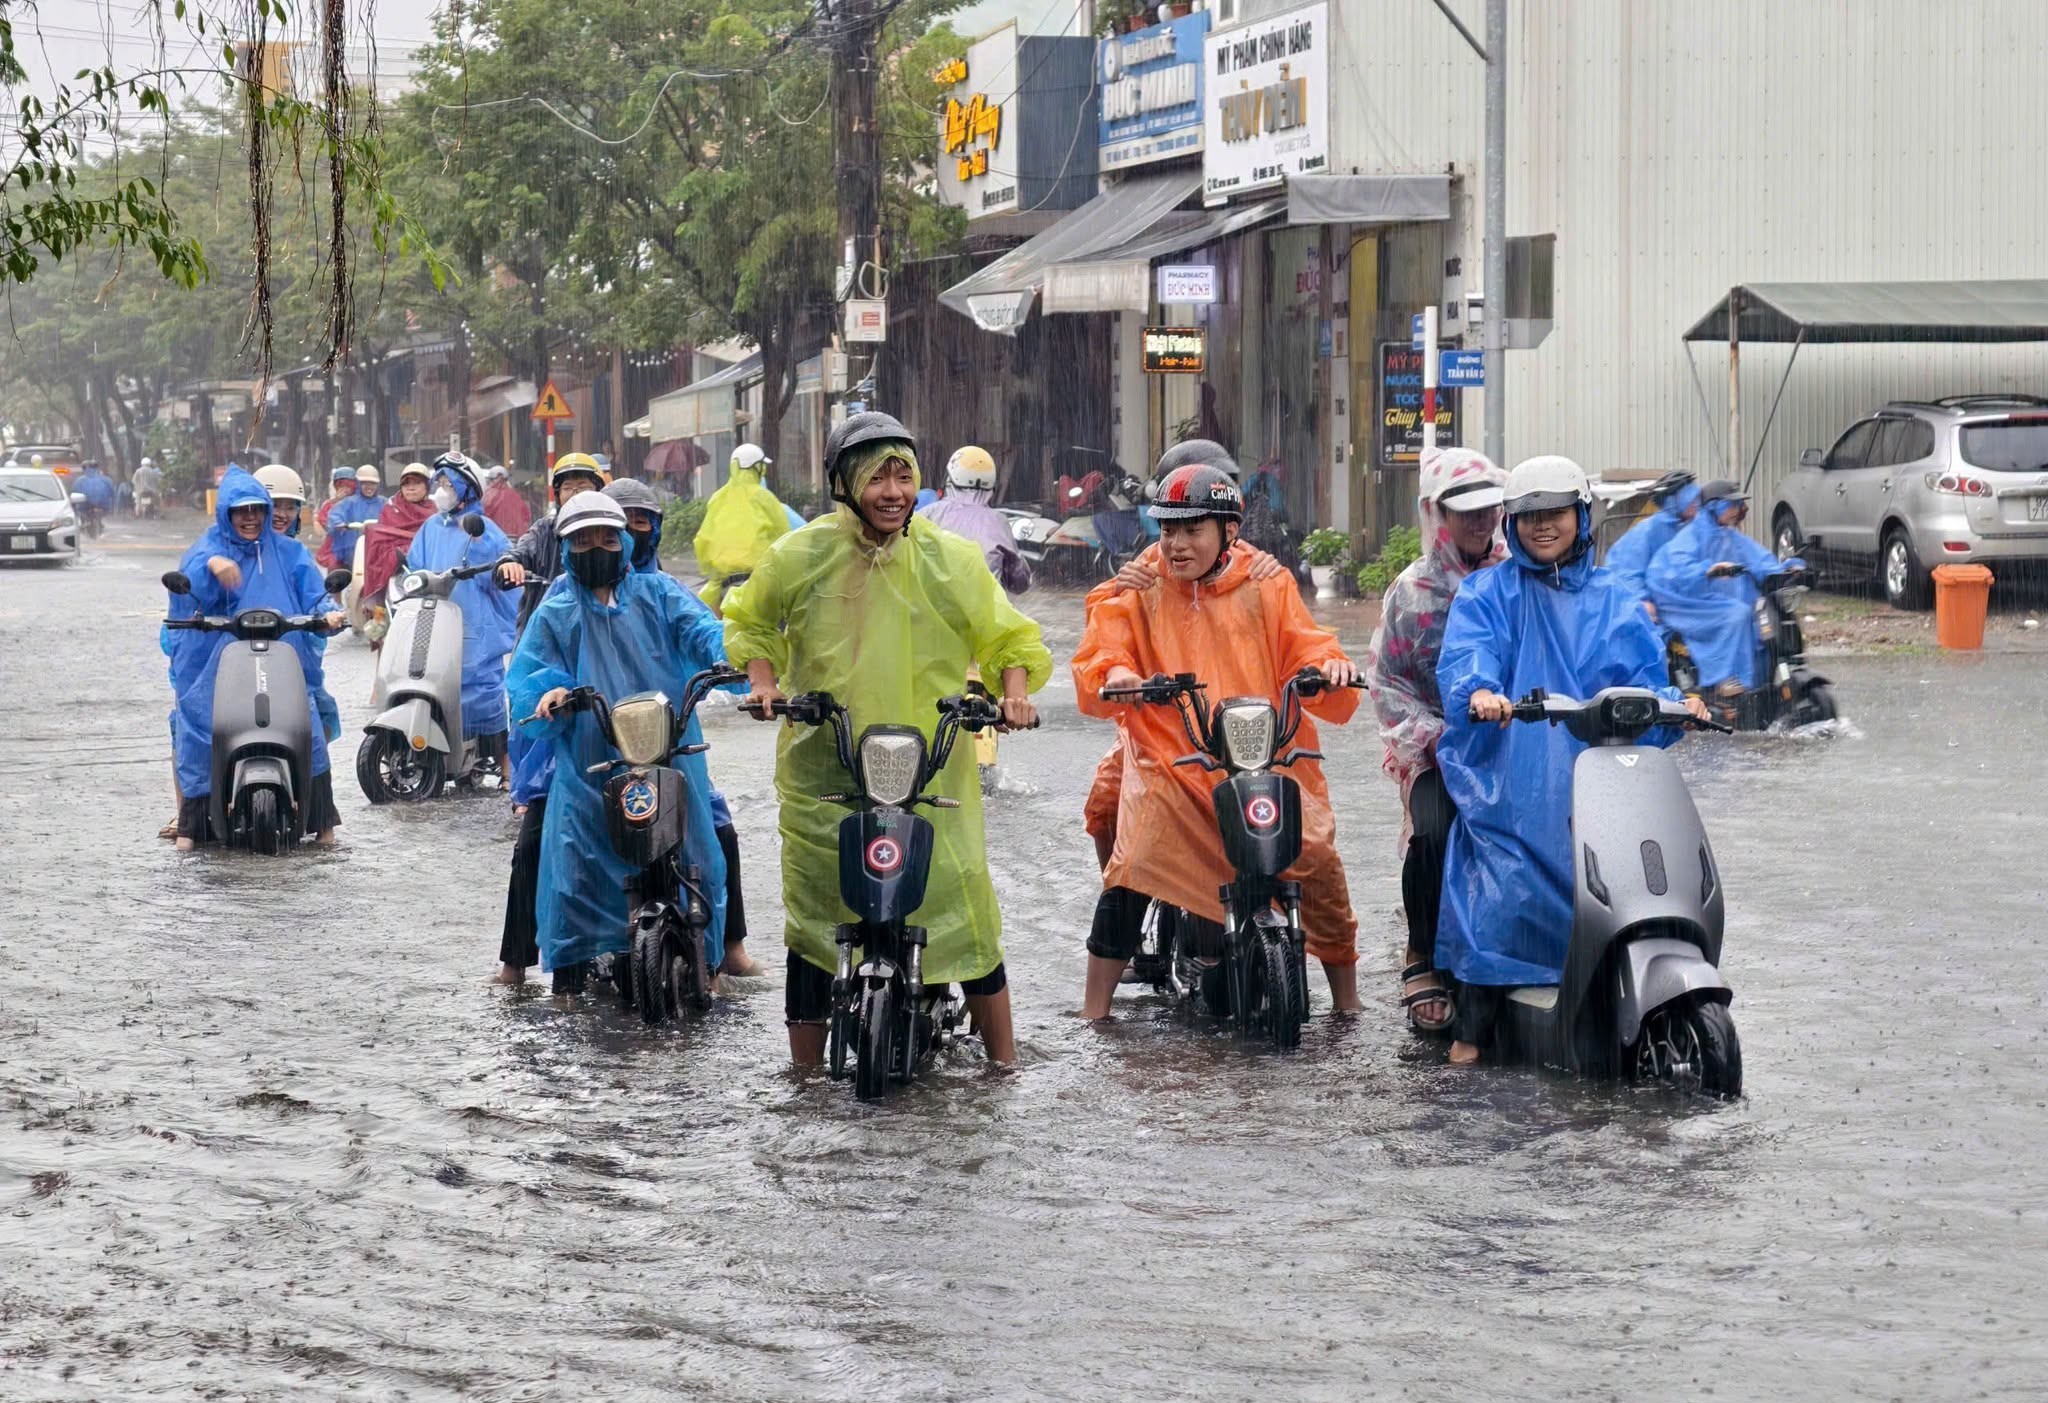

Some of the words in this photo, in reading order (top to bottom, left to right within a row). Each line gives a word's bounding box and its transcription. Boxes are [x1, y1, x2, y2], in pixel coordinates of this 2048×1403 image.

[1141, 62, 1197, 112] MINH
[1188, 283, 1210, 296] MINH
[1405, 430, 1452, 439] Costics
